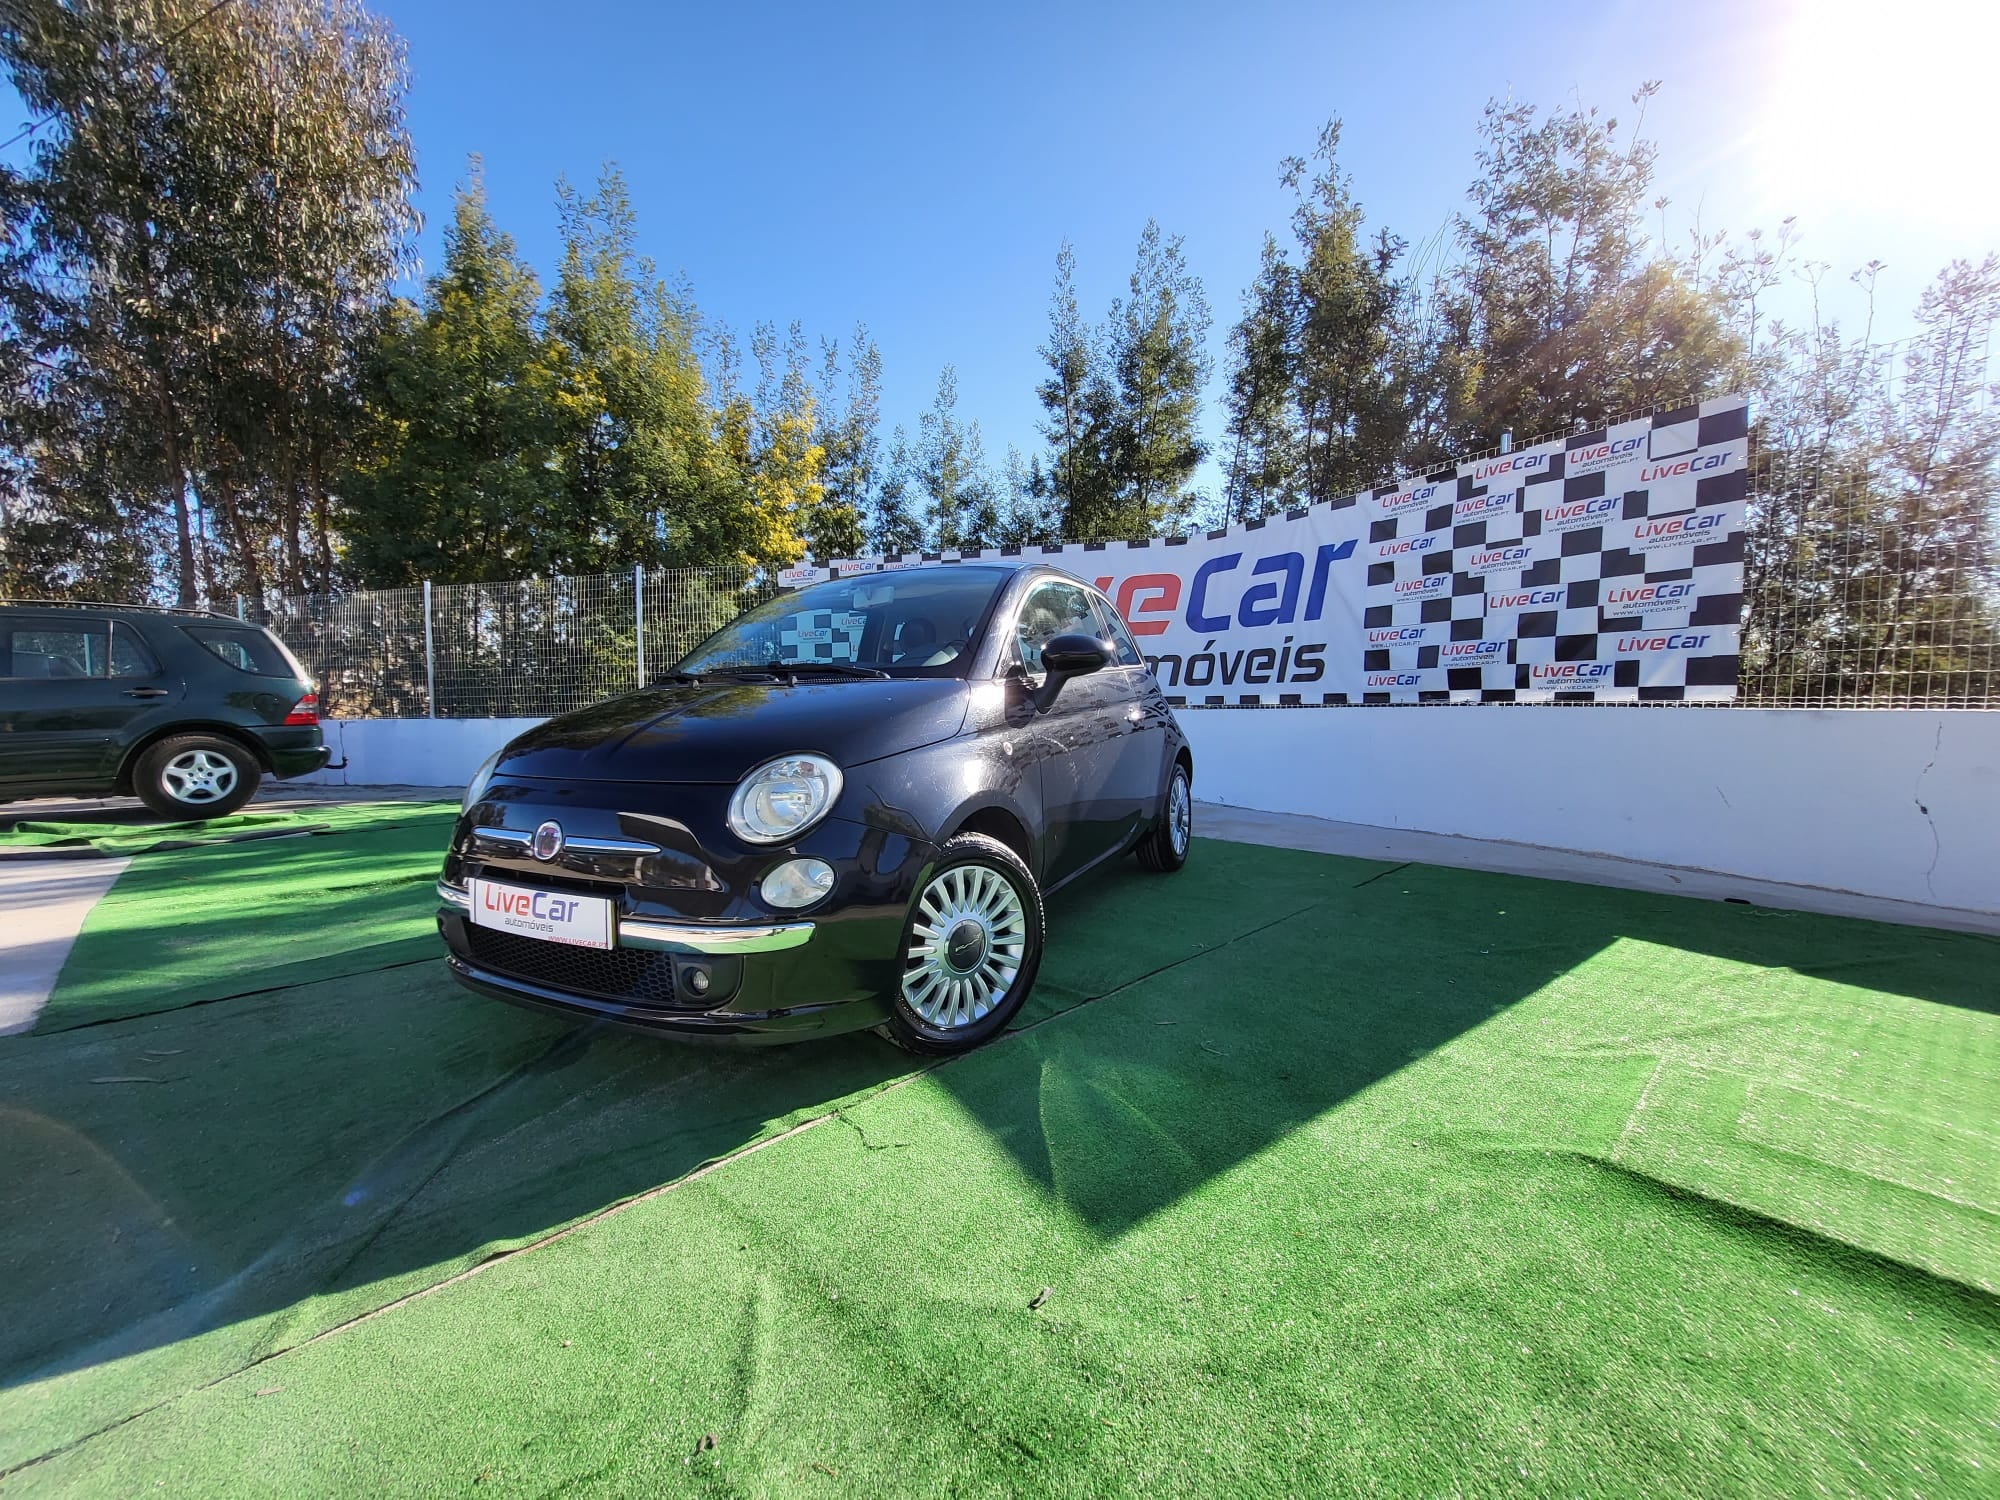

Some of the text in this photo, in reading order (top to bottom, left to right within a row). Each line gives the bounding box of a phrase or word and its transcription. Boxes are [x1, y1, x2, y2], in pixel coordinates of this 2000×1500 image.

[1570, 435, 1646, 464] LiveCar
[1475, 453, 1547, 480] LiveCar
[1640, 451, 1732, 482] LiveCar
[1382, 486, 1438, 508] LiveCar
[1455, 493, 1514, 514] LiveCar
[1544, 497, 1621, 521] LiveCar
[1634, 513, 1727, 538] LiveCar
[1649, 529, 1711, 544] automóveis
[1380, 537, 1436, 556] LiveCar
[1471, 548, 1533, 565] LiveCar
[784, 569, 818, 579] LiveCar
[840, 562, 876, 572] LiveCar
[1094, 539, 1358, 636] eCar
[1394, 576, 1448, 592] LiveCar
[1608, 583, 1696, 603] LiveCar
[1490, 590, 1566, 609] LiveCar
[1623, 598, 1681, 609] automóveis
[1369, 628, 1426, 642] LiveCar
[1617, 634, 1710, 652] LiveCar
[1442, 641, 1507, 656] LiveCar
[1533, 664, 1613, 677] LiveCar
[1367, 674, 1421, 686] LiveCar
[485, 884, 579, 922] LiveCar
[504, 917, 554, 933] automóveis
